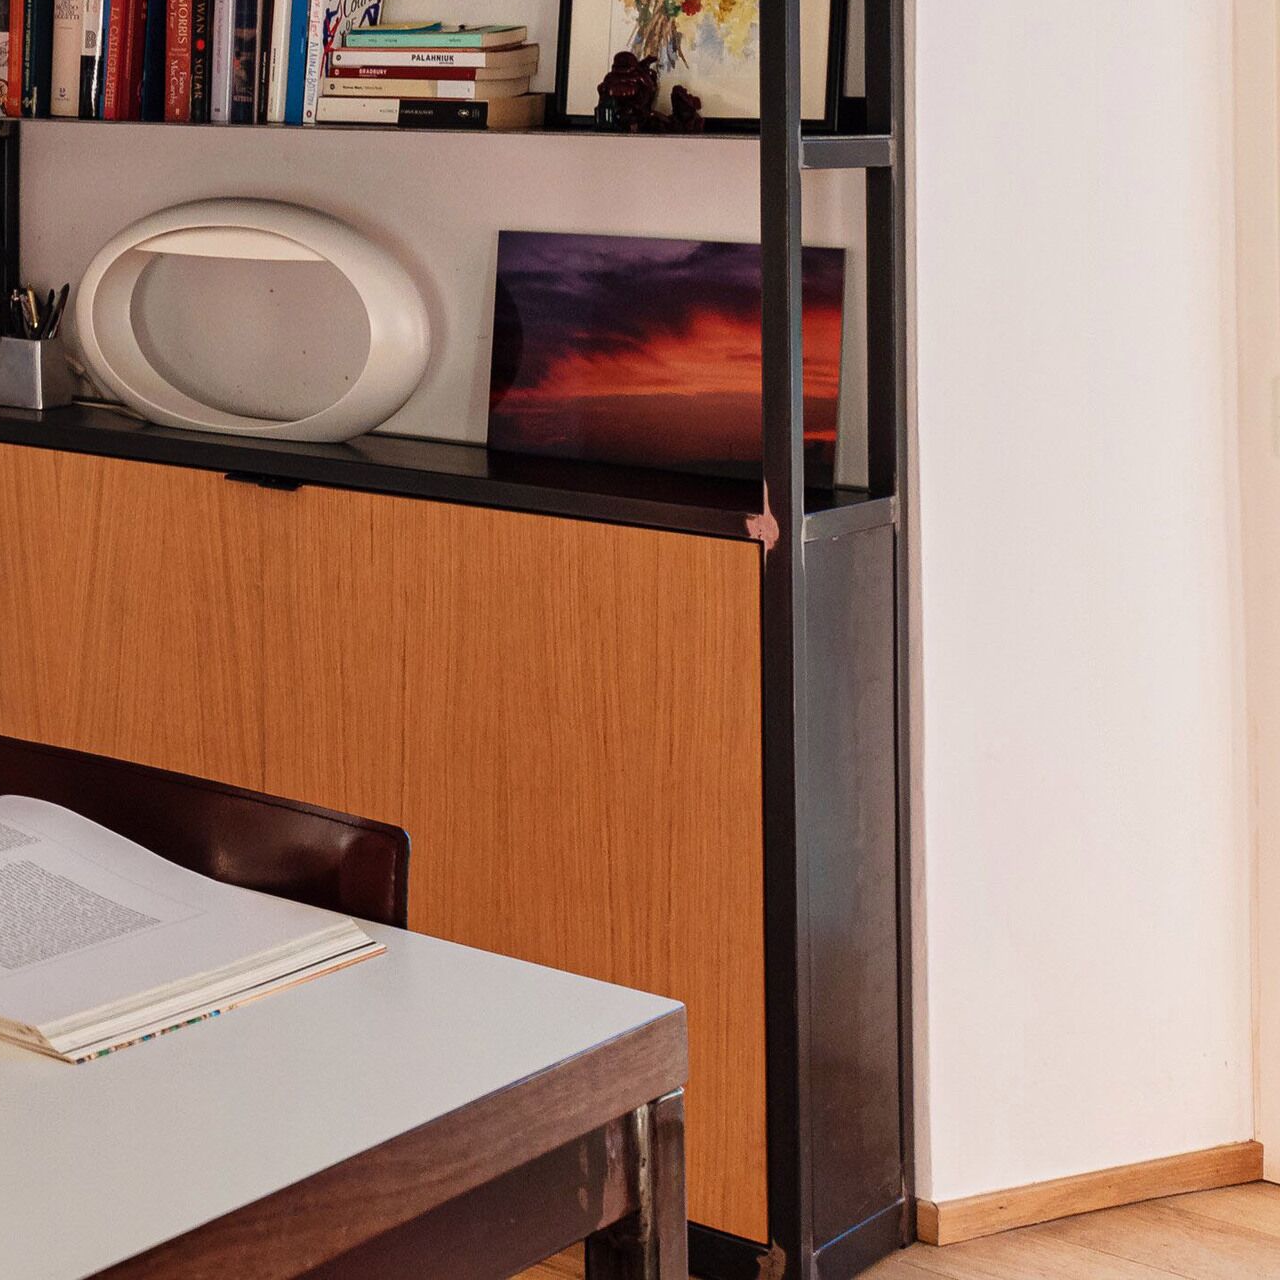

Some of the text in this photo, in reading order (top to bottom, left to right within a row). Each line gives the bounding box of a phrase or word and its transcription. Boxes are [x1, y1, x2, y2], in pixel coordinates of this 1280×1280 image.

[345, 17, 357, 31] OF
[104, 6, 120, 108] LA CALLIGRAPHIE
[310, 41, 319, 67] ALAIN
[411, 54, 454, 62] PALAHNIUK
[168, 59, 178, 105] MacCarthy
[179, 71, 187, 94] Fiona
[194, 57, 204, 99] SOLAR
[307, 78, 317, 106] BOTTON
